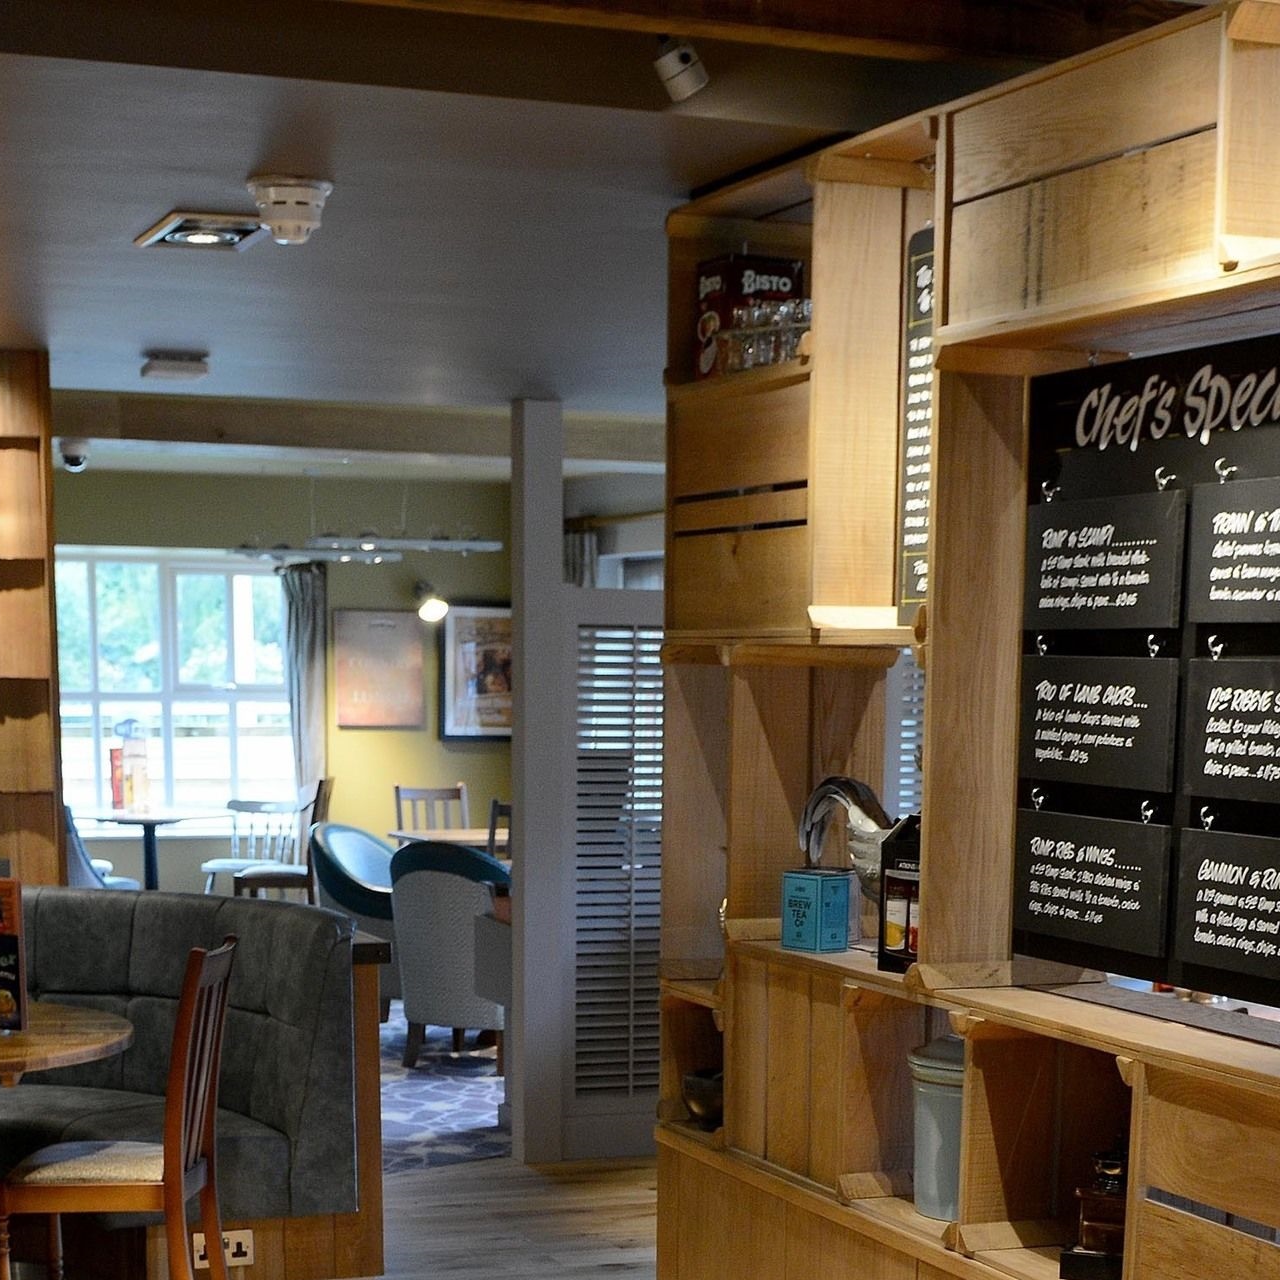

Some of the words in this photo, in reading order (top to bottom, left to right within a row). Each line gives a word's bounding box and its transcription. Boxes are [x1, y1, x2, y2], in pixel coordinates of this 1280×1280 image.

[742, 269, 792, 295] BISTO
[1075, 374, 1176, 452] Chef's
[1059, 683, 1073, 701] OF
[1233, 718, 1244, 733] to
[1243, 723, 1262, 738] your
[1249, 871, 1261, 889] &
[788, 898, 812, 909] BREW
[792, 909, 807, 919] TEA
[1233, 917, 1247, 932] egg
